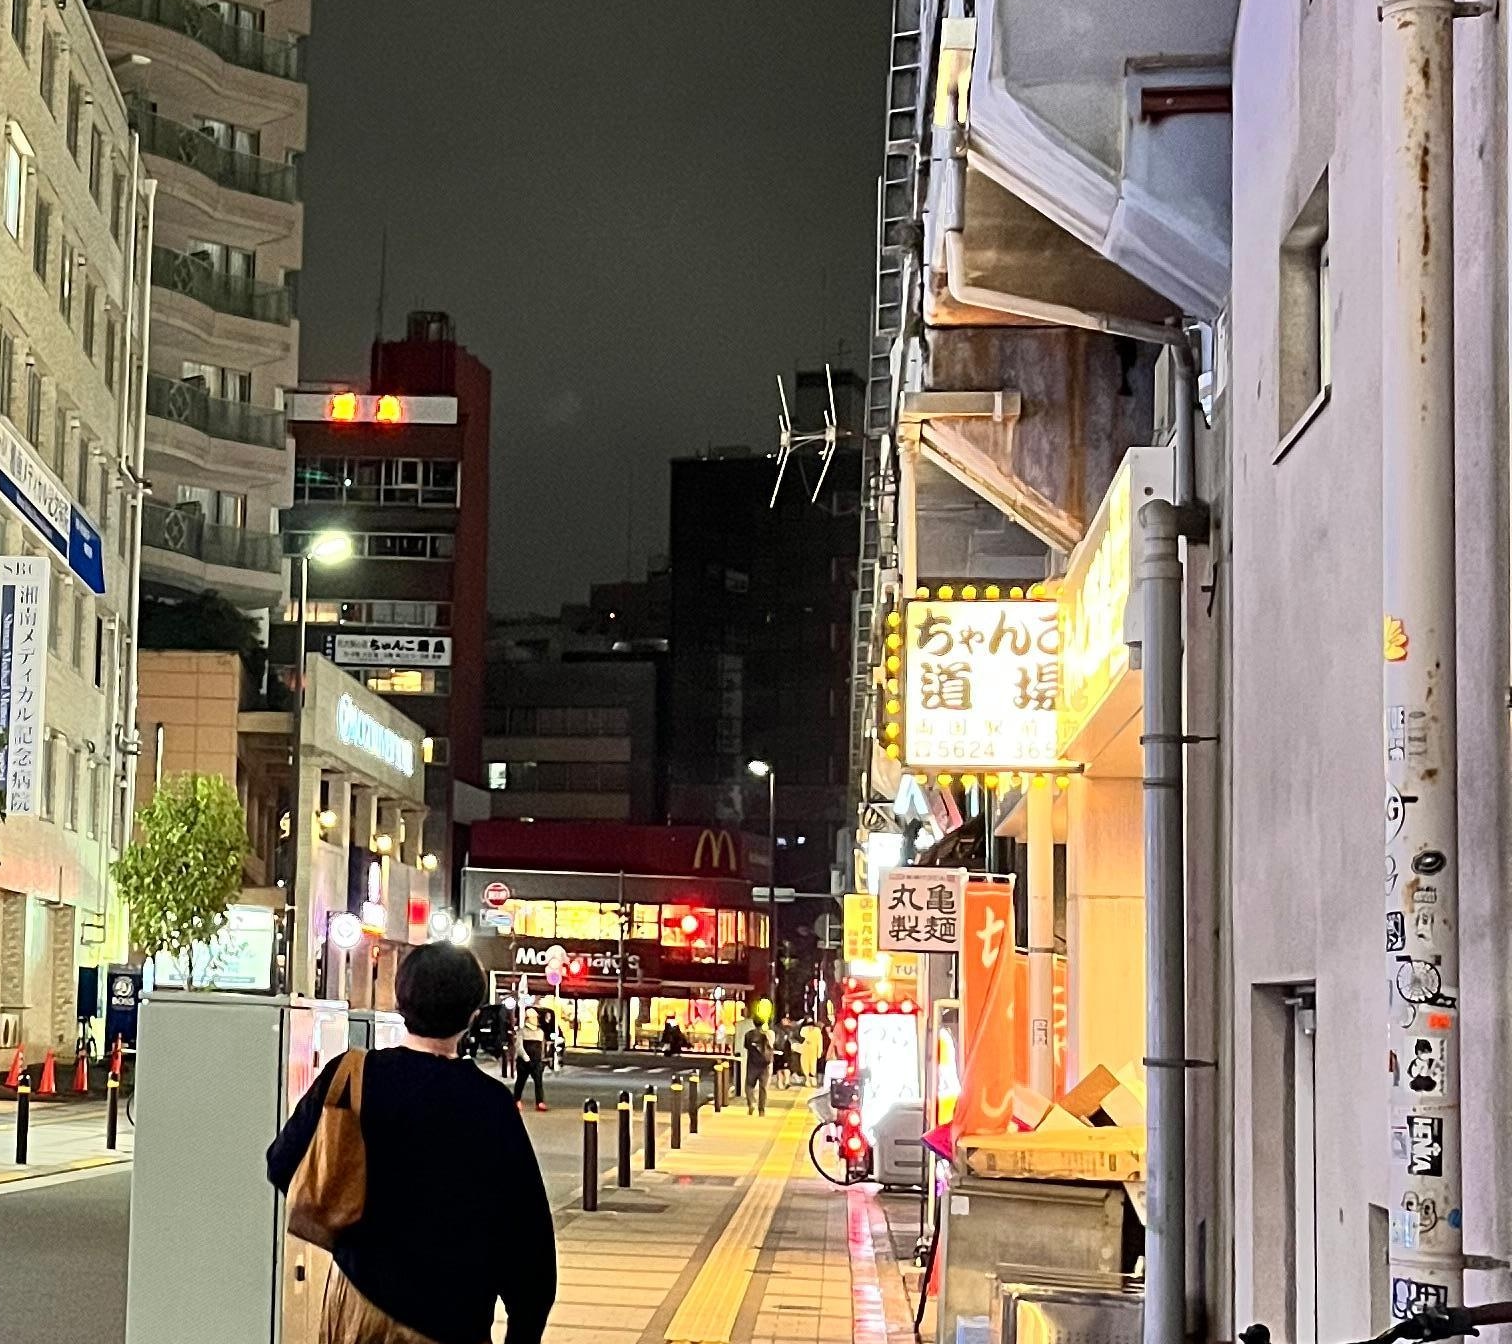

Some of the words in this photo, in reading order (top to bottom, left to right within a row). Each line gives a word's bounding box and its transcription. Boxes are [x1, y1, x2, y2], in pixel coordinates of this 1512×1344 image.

[4, 562, 33, 575] SBC
[11, 585, 39, 811] 湘南メディカル記念病院
[888, 884, 956, 914] 丸亀
[888, 915, 957, 943] 製麺
